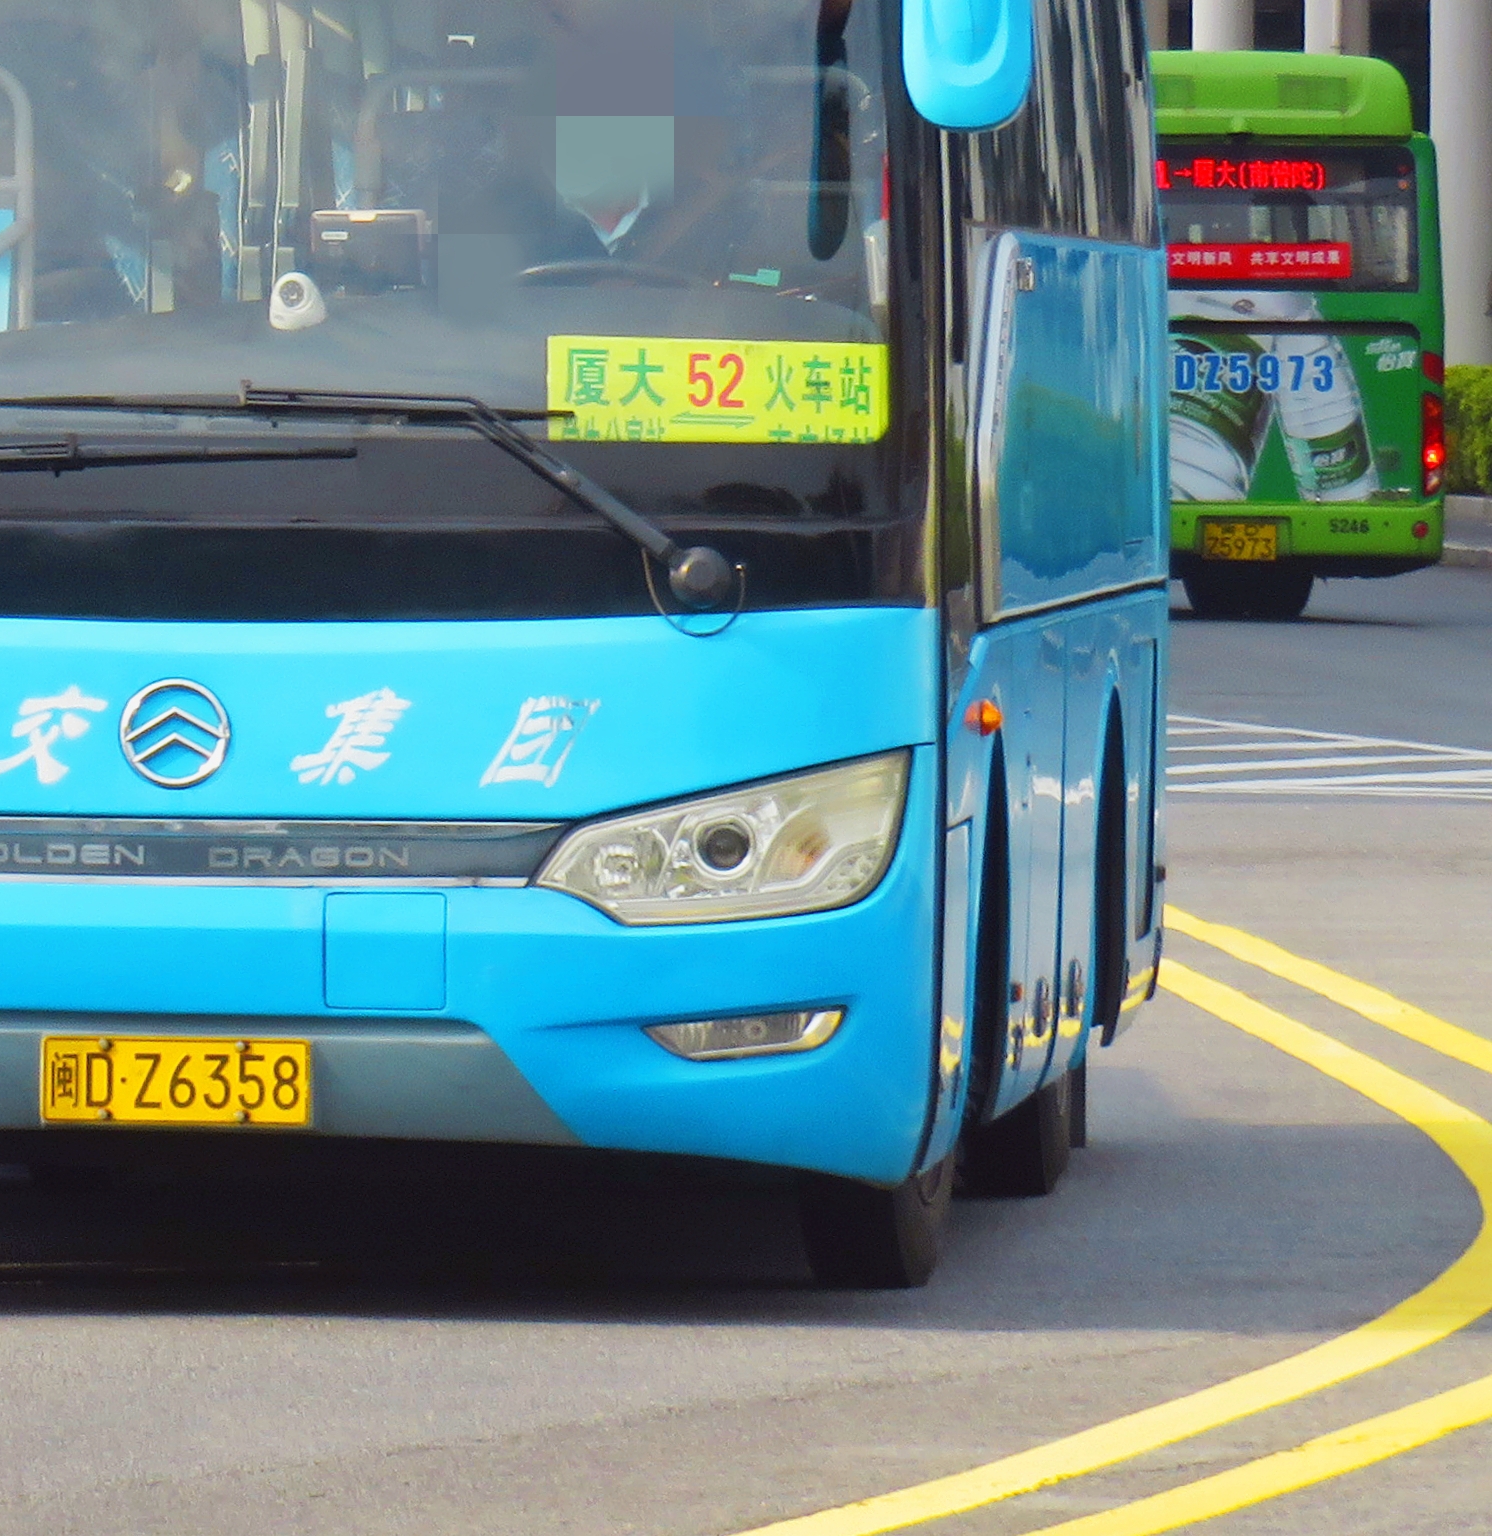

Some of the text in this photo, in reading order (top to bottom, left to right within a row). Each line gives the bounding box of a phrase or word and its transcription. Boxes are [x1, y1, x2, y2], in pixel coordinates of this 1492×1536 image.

[566, 347, 873, 415] 厦大 52 火车站
[1173, 354, 1334, 393] DZ5973
[209, 846, 410, 868] DRAGON
[50, 1051, 301, 1111] 闽D·Z6358
